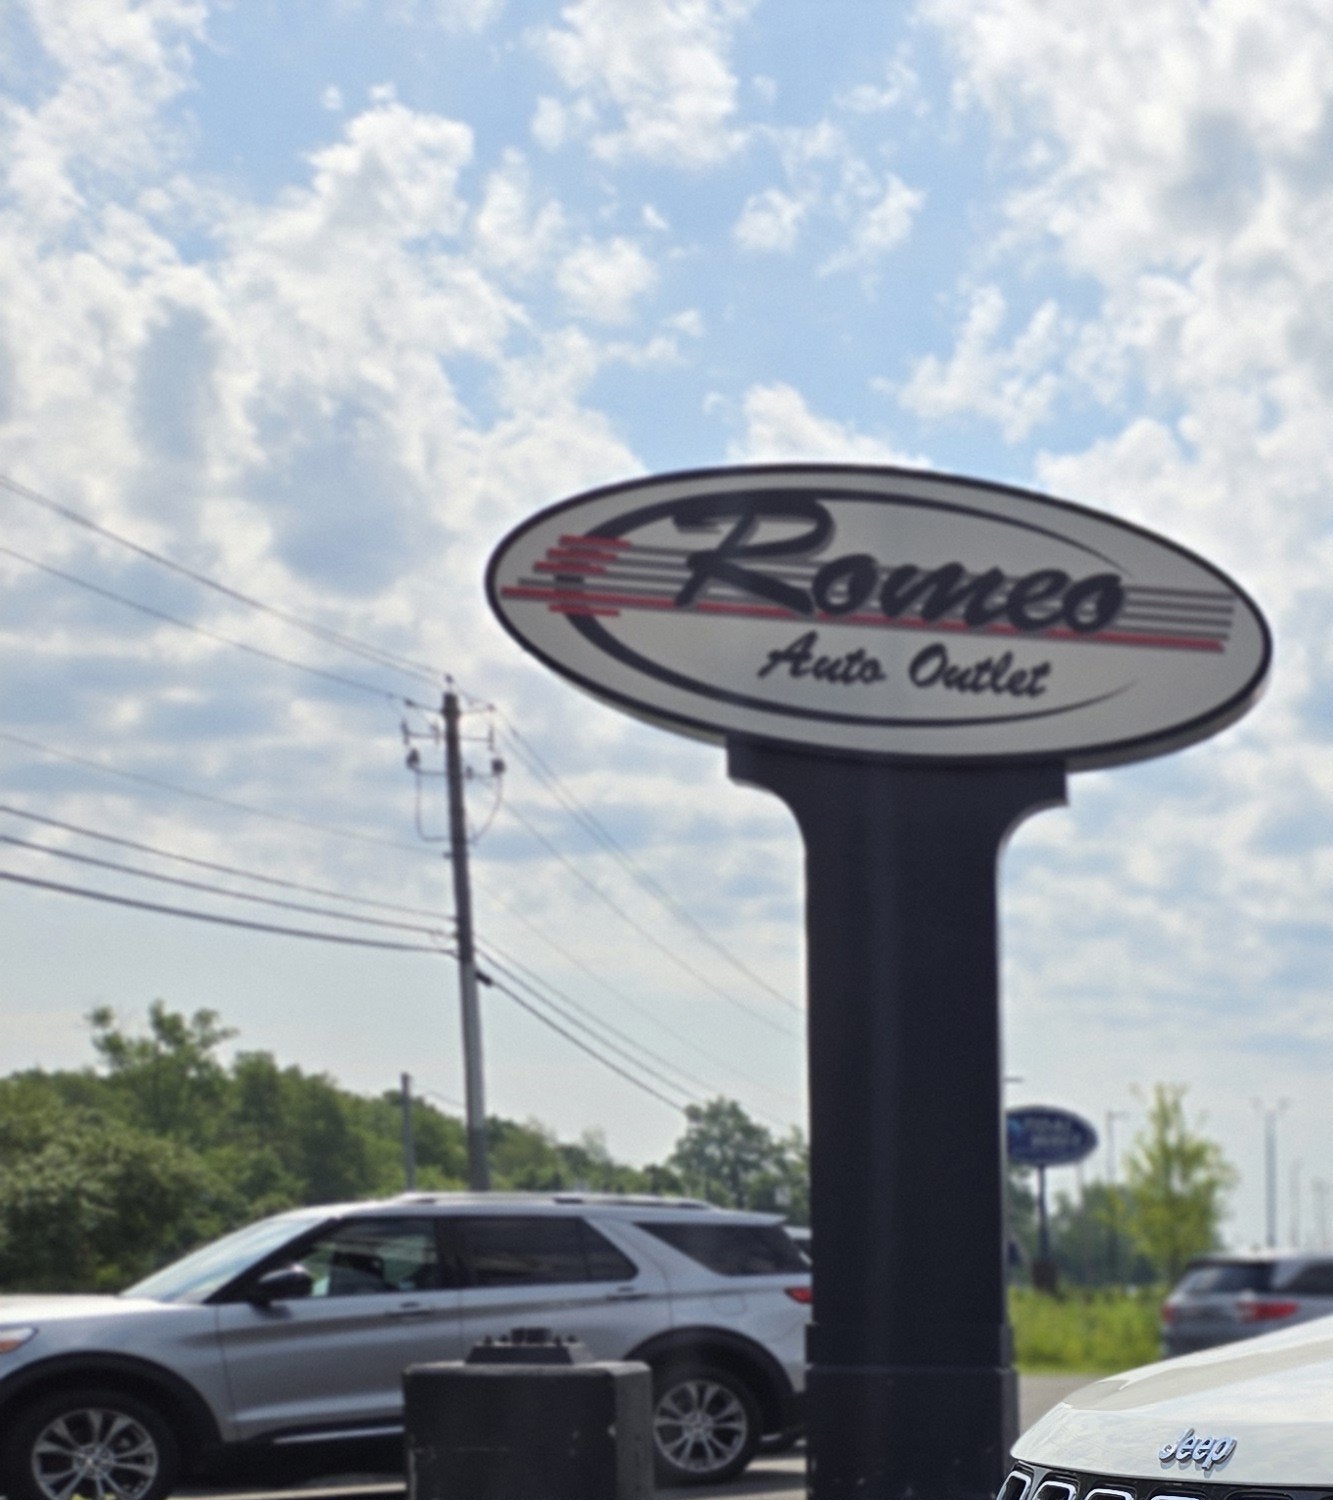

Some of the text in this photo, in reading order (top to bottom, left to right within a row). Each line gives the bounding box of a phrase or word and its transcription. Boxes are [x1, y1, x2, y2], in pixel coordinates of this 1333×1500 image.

[670, 488, 1126, 633] Romeo
[758, 631, 1052, 698] Auto Outlet
[1159, 1428, 1237, 1471] Jeep
